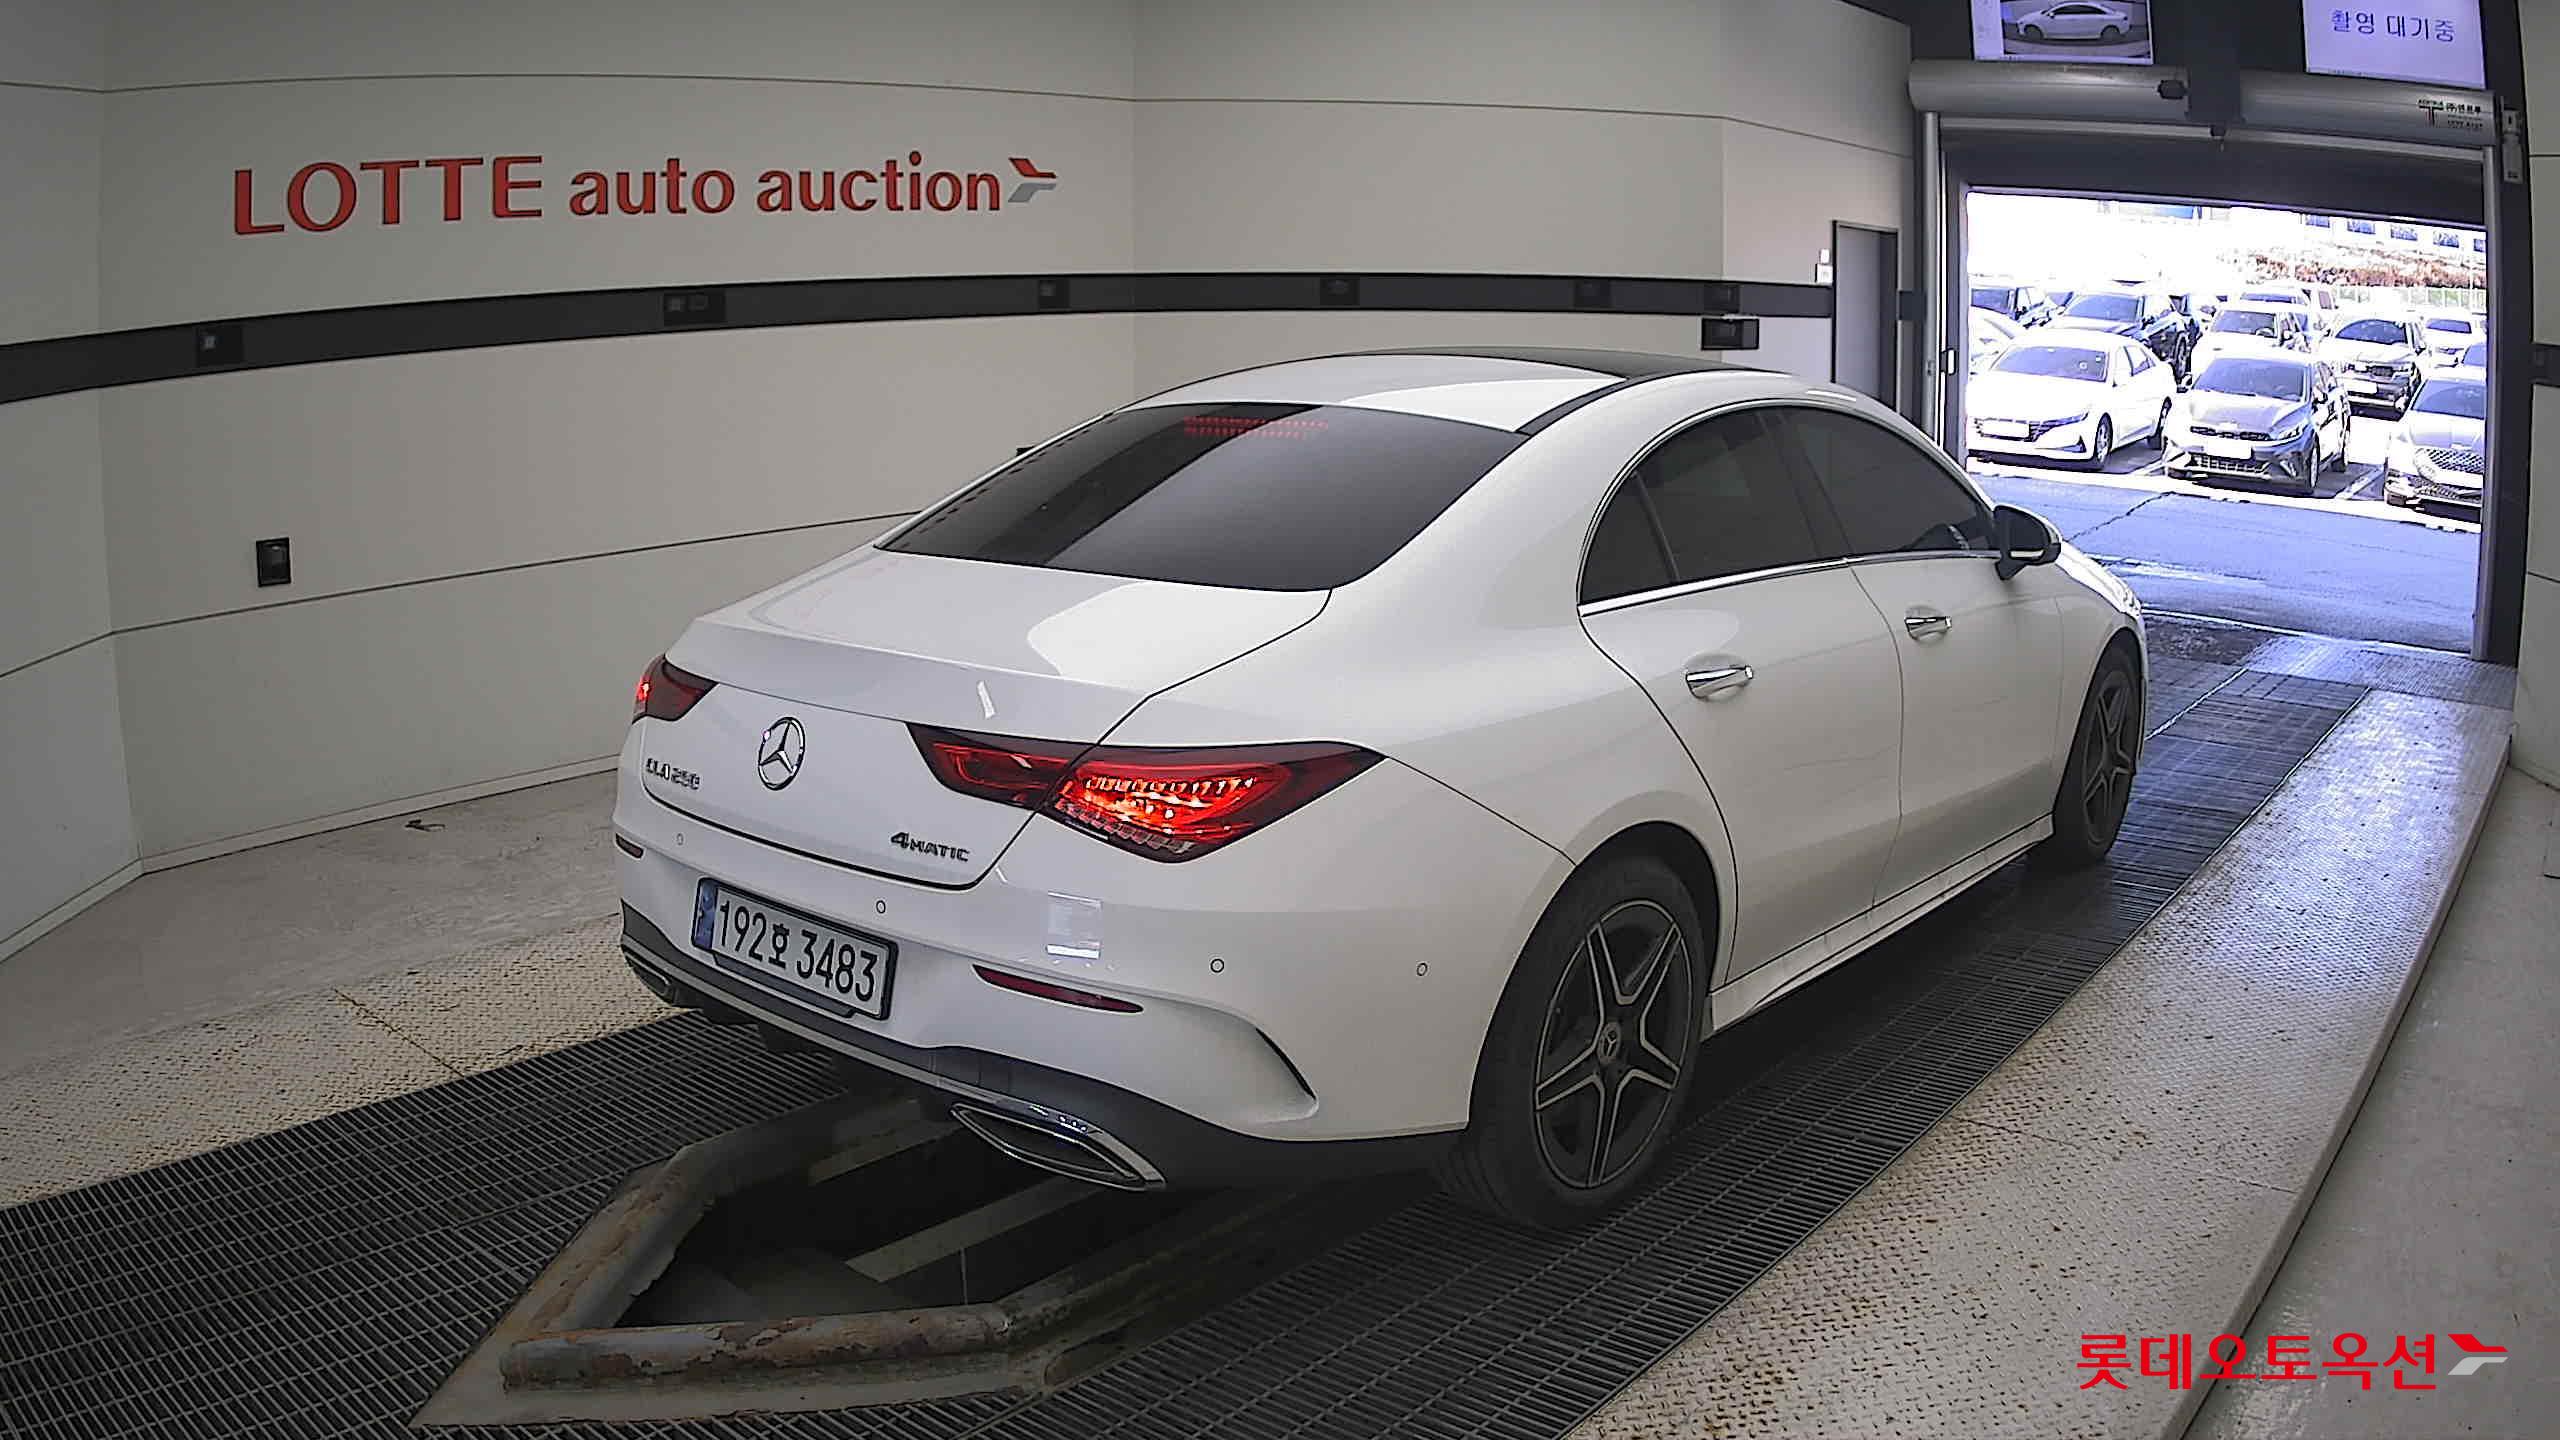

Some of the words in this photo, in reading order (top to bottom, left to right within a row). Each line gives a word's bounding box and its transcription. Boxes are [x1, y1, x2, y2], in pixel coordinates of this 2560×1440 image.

[2386, 15, 2455, 43] 대기중
[234, 155, 542, 236] LOTTE
[569, 157, 735, 216] auto
[756, 150, 1001, 212] auction
[890, 831, 970, 862] 4MATIC
[796, 928, 878, 1002] 3483
